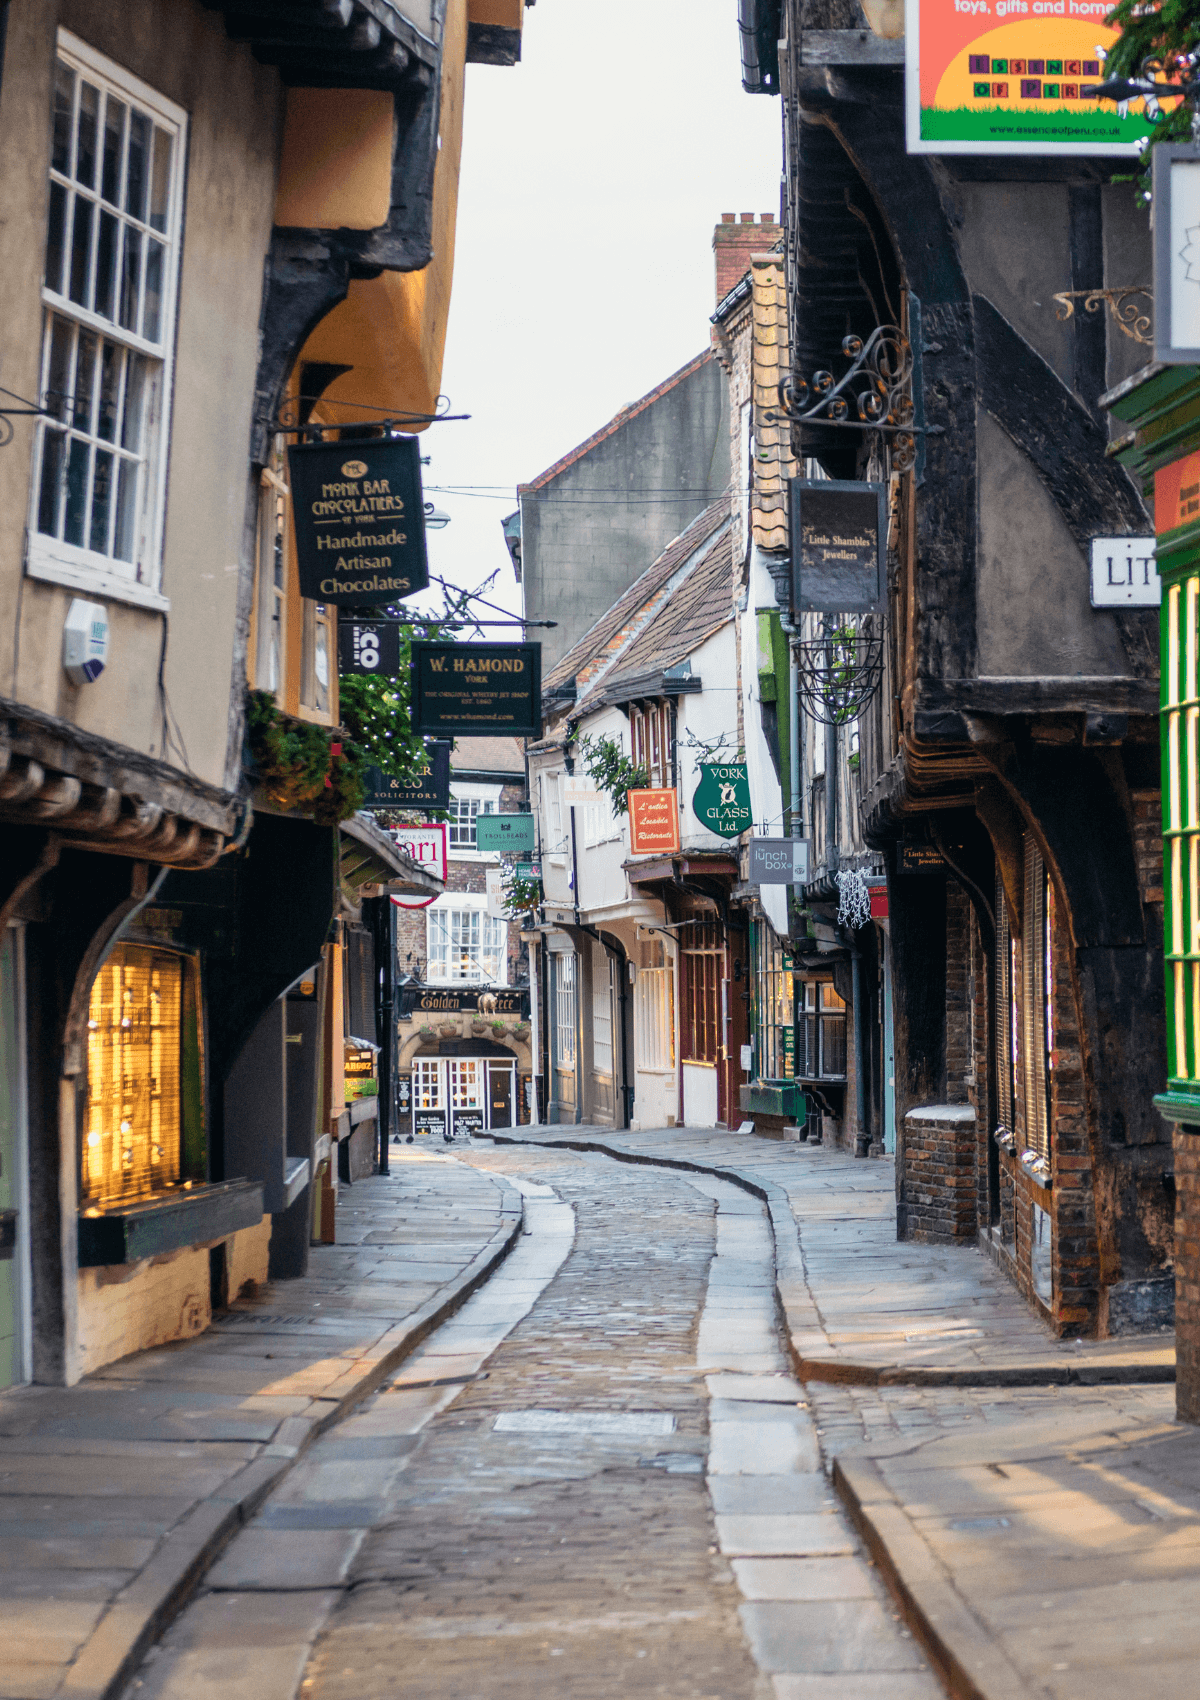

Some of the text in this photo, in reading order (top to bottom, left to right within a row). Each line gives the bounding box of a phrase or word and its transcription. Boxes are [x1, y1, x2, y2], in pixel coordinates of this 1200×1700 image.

[955, 0, 991, 16] toys,
[995, 0, 1028, 17] gifts
[1033, 0, 1065, 14] and
[970, 56, 1098, 75] ESSENCE
[975, 80, 1096, 98] OF PER
[322, 479, 390, 498] MONK BAR
[312, 496, 404, 515] CHOCOLATIERS
[342, 514, 377, 524] OF YORK
[317, 529, 407, 549] Handmade
[809, 534, 871, 547] Little Shambles
[822, 549, 858, 561] Jewellers
[335, 554, 392, 571] Artisan
[320, 575, 411, 594] Chocolates
[430, 655, 524, 673] W. HAMOND
[465, 675, 488, 683] YORK
[440, 712, 515, 720] www.whamond.com
[710, 768, 747, 780] YORK
[390, 779, 400, 789] &
[706, 807, 750, 819] GLASS
[719, 821, 738, 831] Ltd.
[638, 832, 673, 840] Ristorante
[395, 841, 439, 861] ari
[755, 850, 787, 860] lunch
[765, 860, 787, 870] box
[918, 858, 944, 866] Jewellers
[420, 996, 514, 1010] Golden eece
